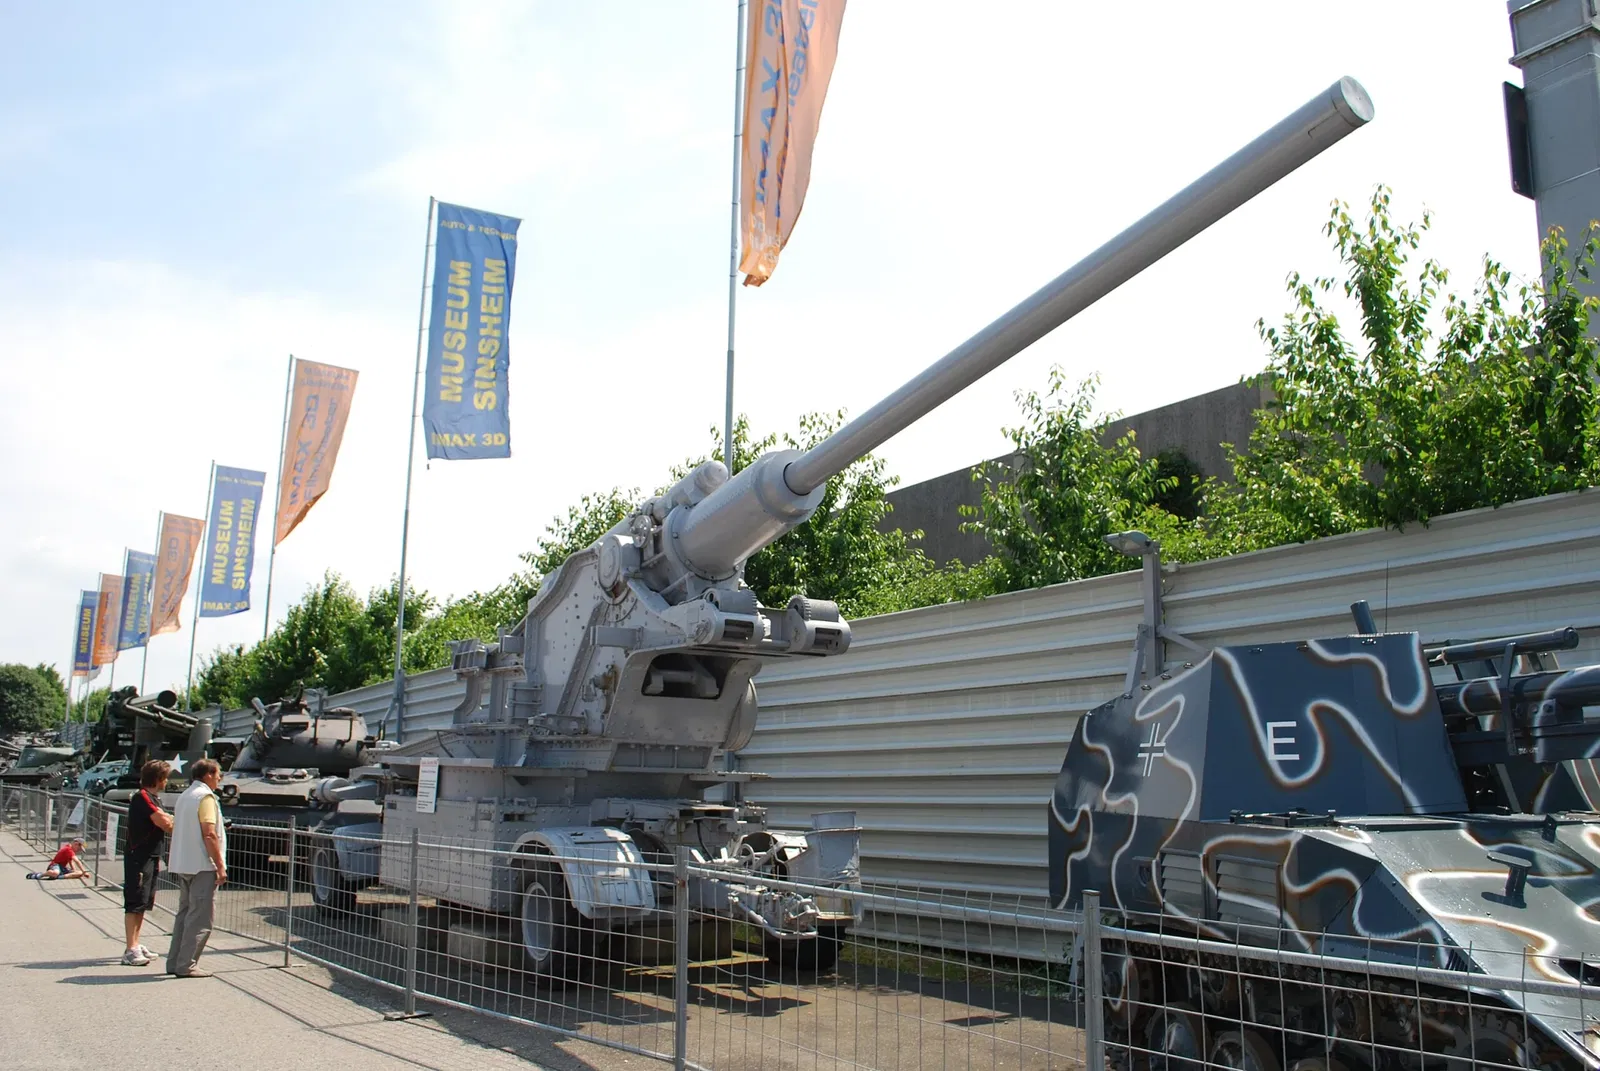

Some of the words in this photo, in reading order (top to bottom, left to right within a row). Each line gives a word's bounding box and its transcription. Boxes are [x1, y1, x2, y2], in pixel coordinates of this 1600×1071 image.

[440, 219, 466, 230] AUTO
[467, 224, 475, 232] &
[440, 259, 471, 402] MUSEUM
[473, 257, 506, 411] SINSHEIM
[301, 394, 320, 430] 3D
[431, 432, 476, 447] IMAX
[481, 432, 507, 446] 3D
[167, 537, 179, 562] 3D
[211, 500, 235, 584] MUSEUM
[231, 498, 256, 590] SINSHEIM
[125, 572, 141, 631] MUSEUM
[203, 601, 232, 610] IMAX
[234, 601, 248, 611] 3D
[79, 607, 92, 653] MUSEUM
[1267, 721, 1300, 761] E
